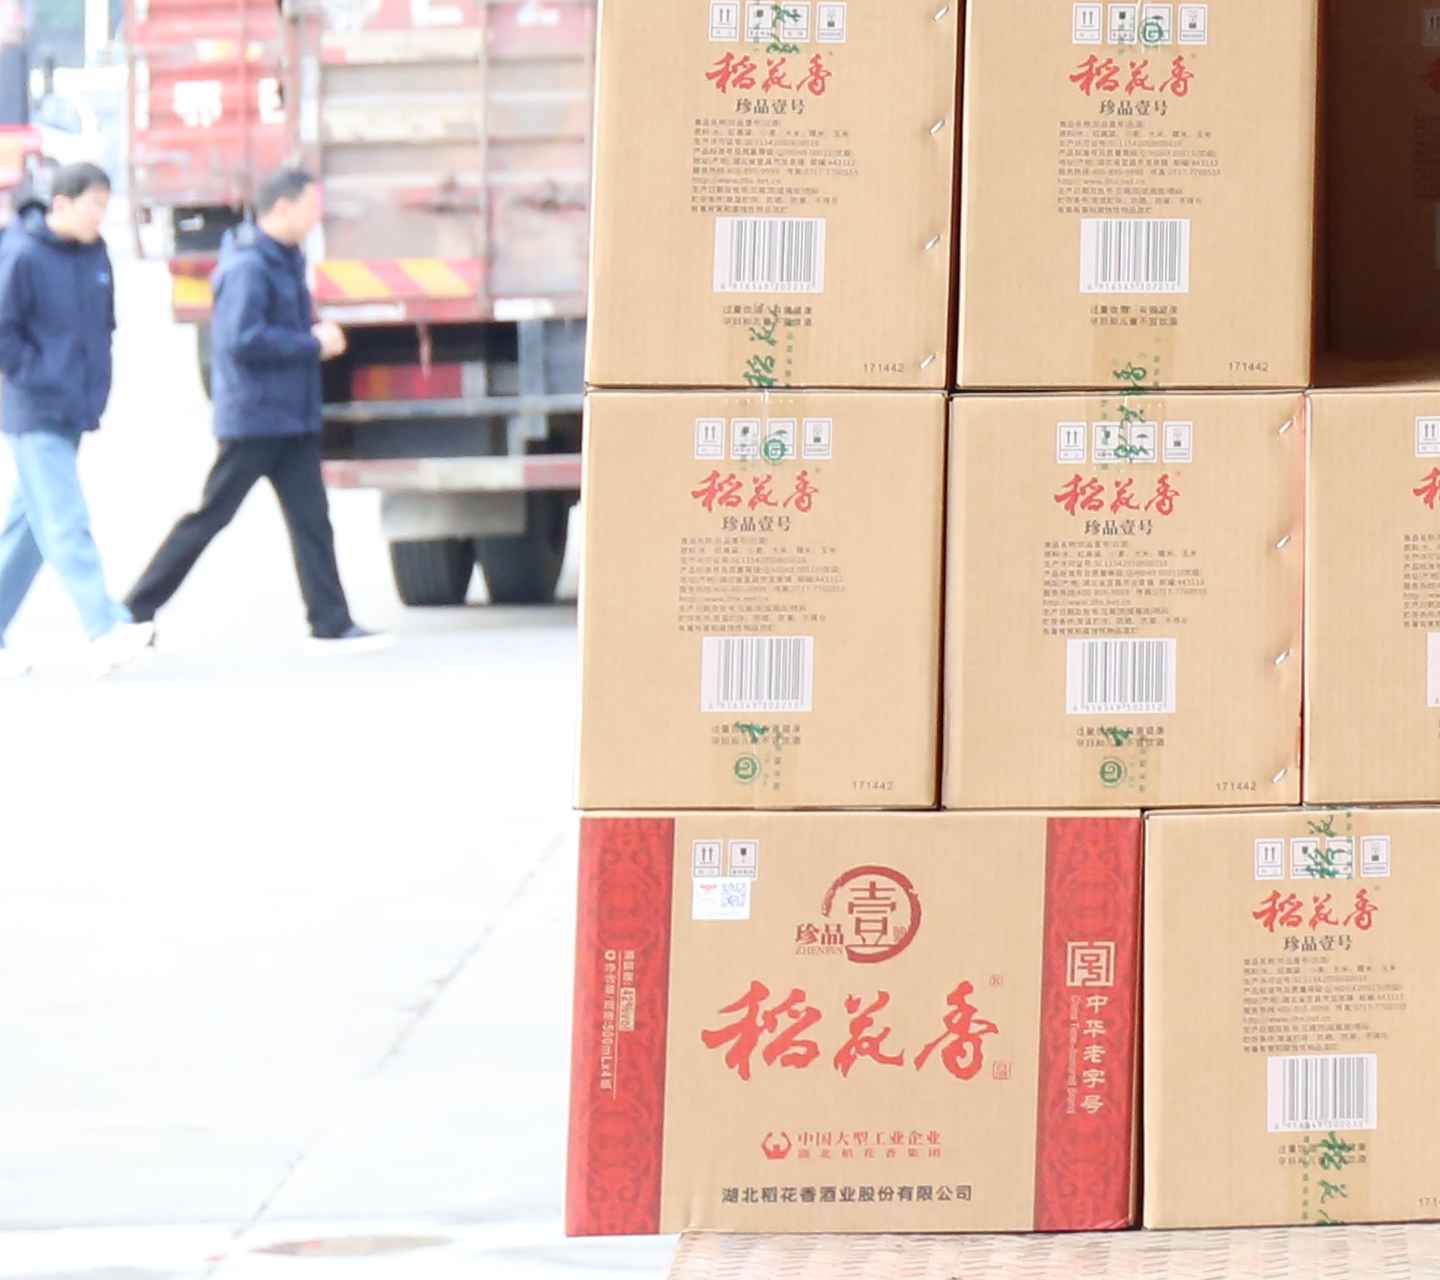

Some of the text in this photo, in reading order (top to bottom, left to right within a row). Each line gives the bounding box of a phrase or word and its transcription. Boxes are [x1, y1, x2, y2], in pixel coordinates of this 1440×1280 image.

[704, 51, 828, 98] 稻花香
[1069, 54, 1192, 98] 稻花香
[734, 97, 805, 116] 珍品壹号
[690, 468, 817, 514] 稻花香
[1054, 473, 1180, 518] 稻花香
[1251, 887, 1377, 934] 稻花香
[1282, 933, 1352, 953] 珍品壹号
[701, 980, 999, 1081] 稻花香
[1081, 995, 1109, 1114] 中华老字号
[797, 1130, 941, 1146] 中国大型工业企业
[721, 1184, 973, 1204] 湖北稻花香酒业股份有限公司
